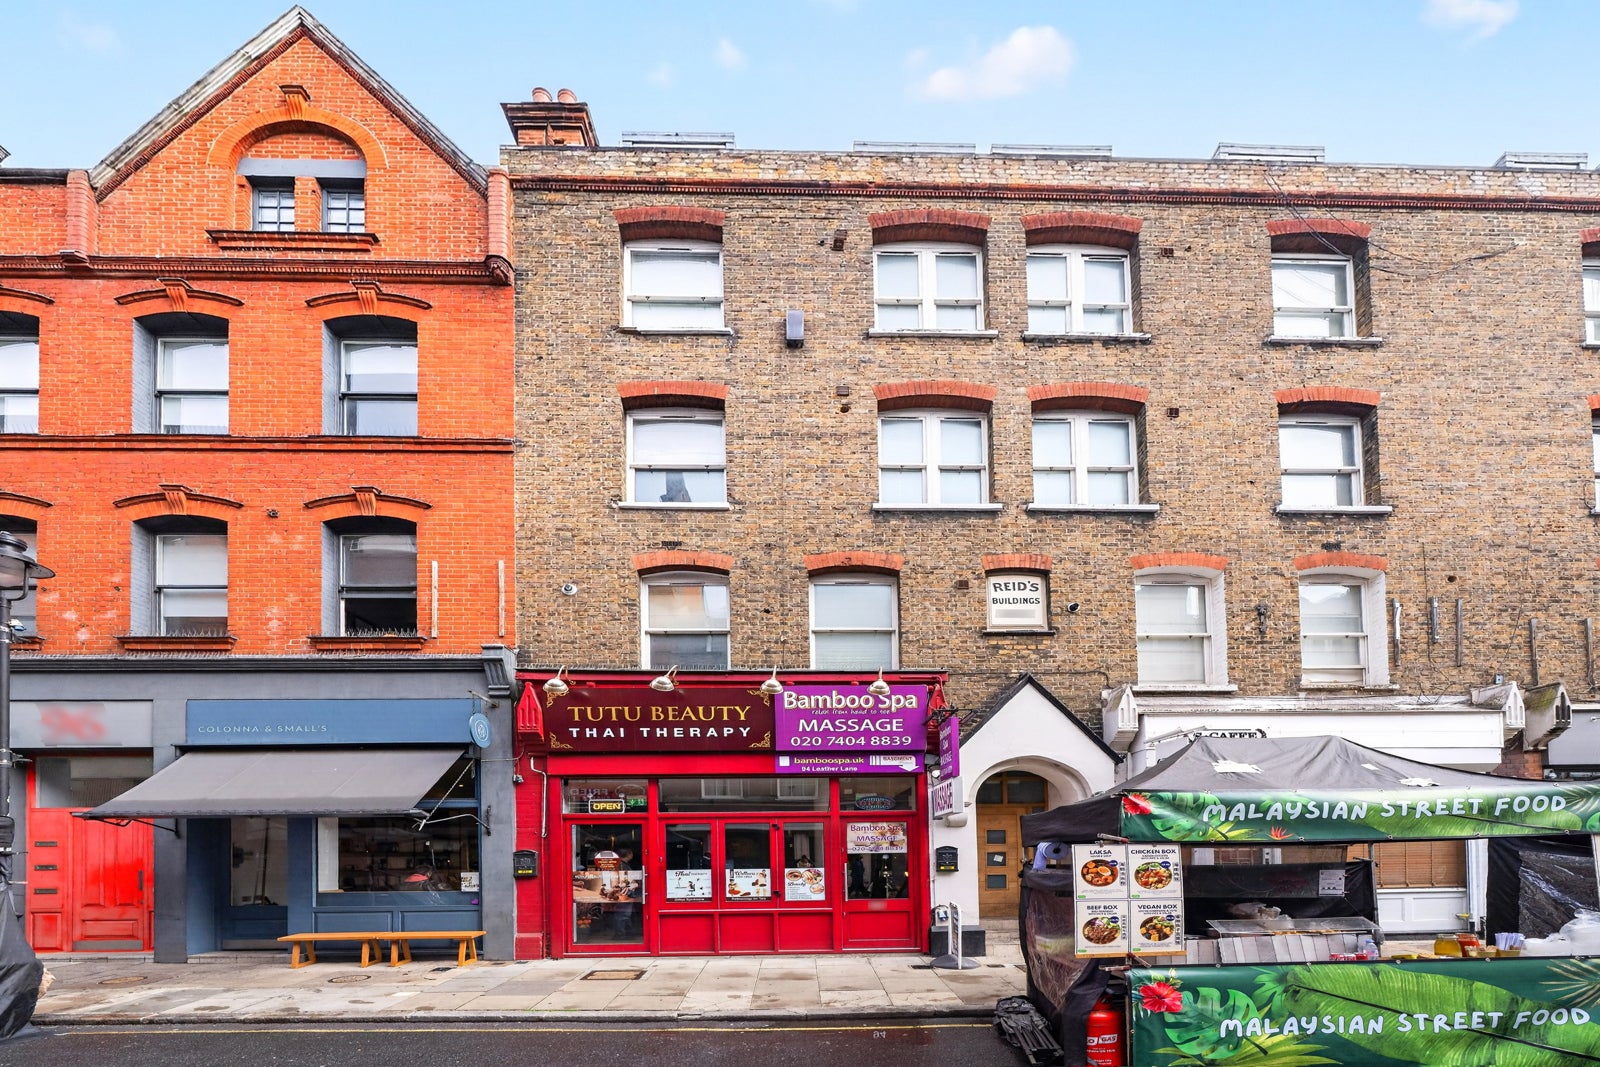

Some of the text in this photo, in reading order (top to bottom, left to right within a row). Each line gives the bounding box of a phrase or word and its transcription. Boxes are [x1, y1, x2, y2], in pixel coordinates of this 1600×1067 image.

[992, 580, 1040, 592] REID'S
[992, 597, 1041, 605] BUILDINGS
[784, 690, 918, 713] Bamboo Spa
[567, 705, 751, 721] TUTU BEAUTY
[798, 719, 904, 732] MASSAGE
[569, 727, 751, 738] THAI THERAPY
[791, 736, 912, 746] 020 7404 8839
[794, 757, 864, 765] bamboospa.uk
[1202, 795, 1567, 822] MALAYSIAN STREET FOOD
[851, 824, 886, 832] Bamboo
[1219, 1007, 1591, 1038] MALAYSIAN STREET FOOD
